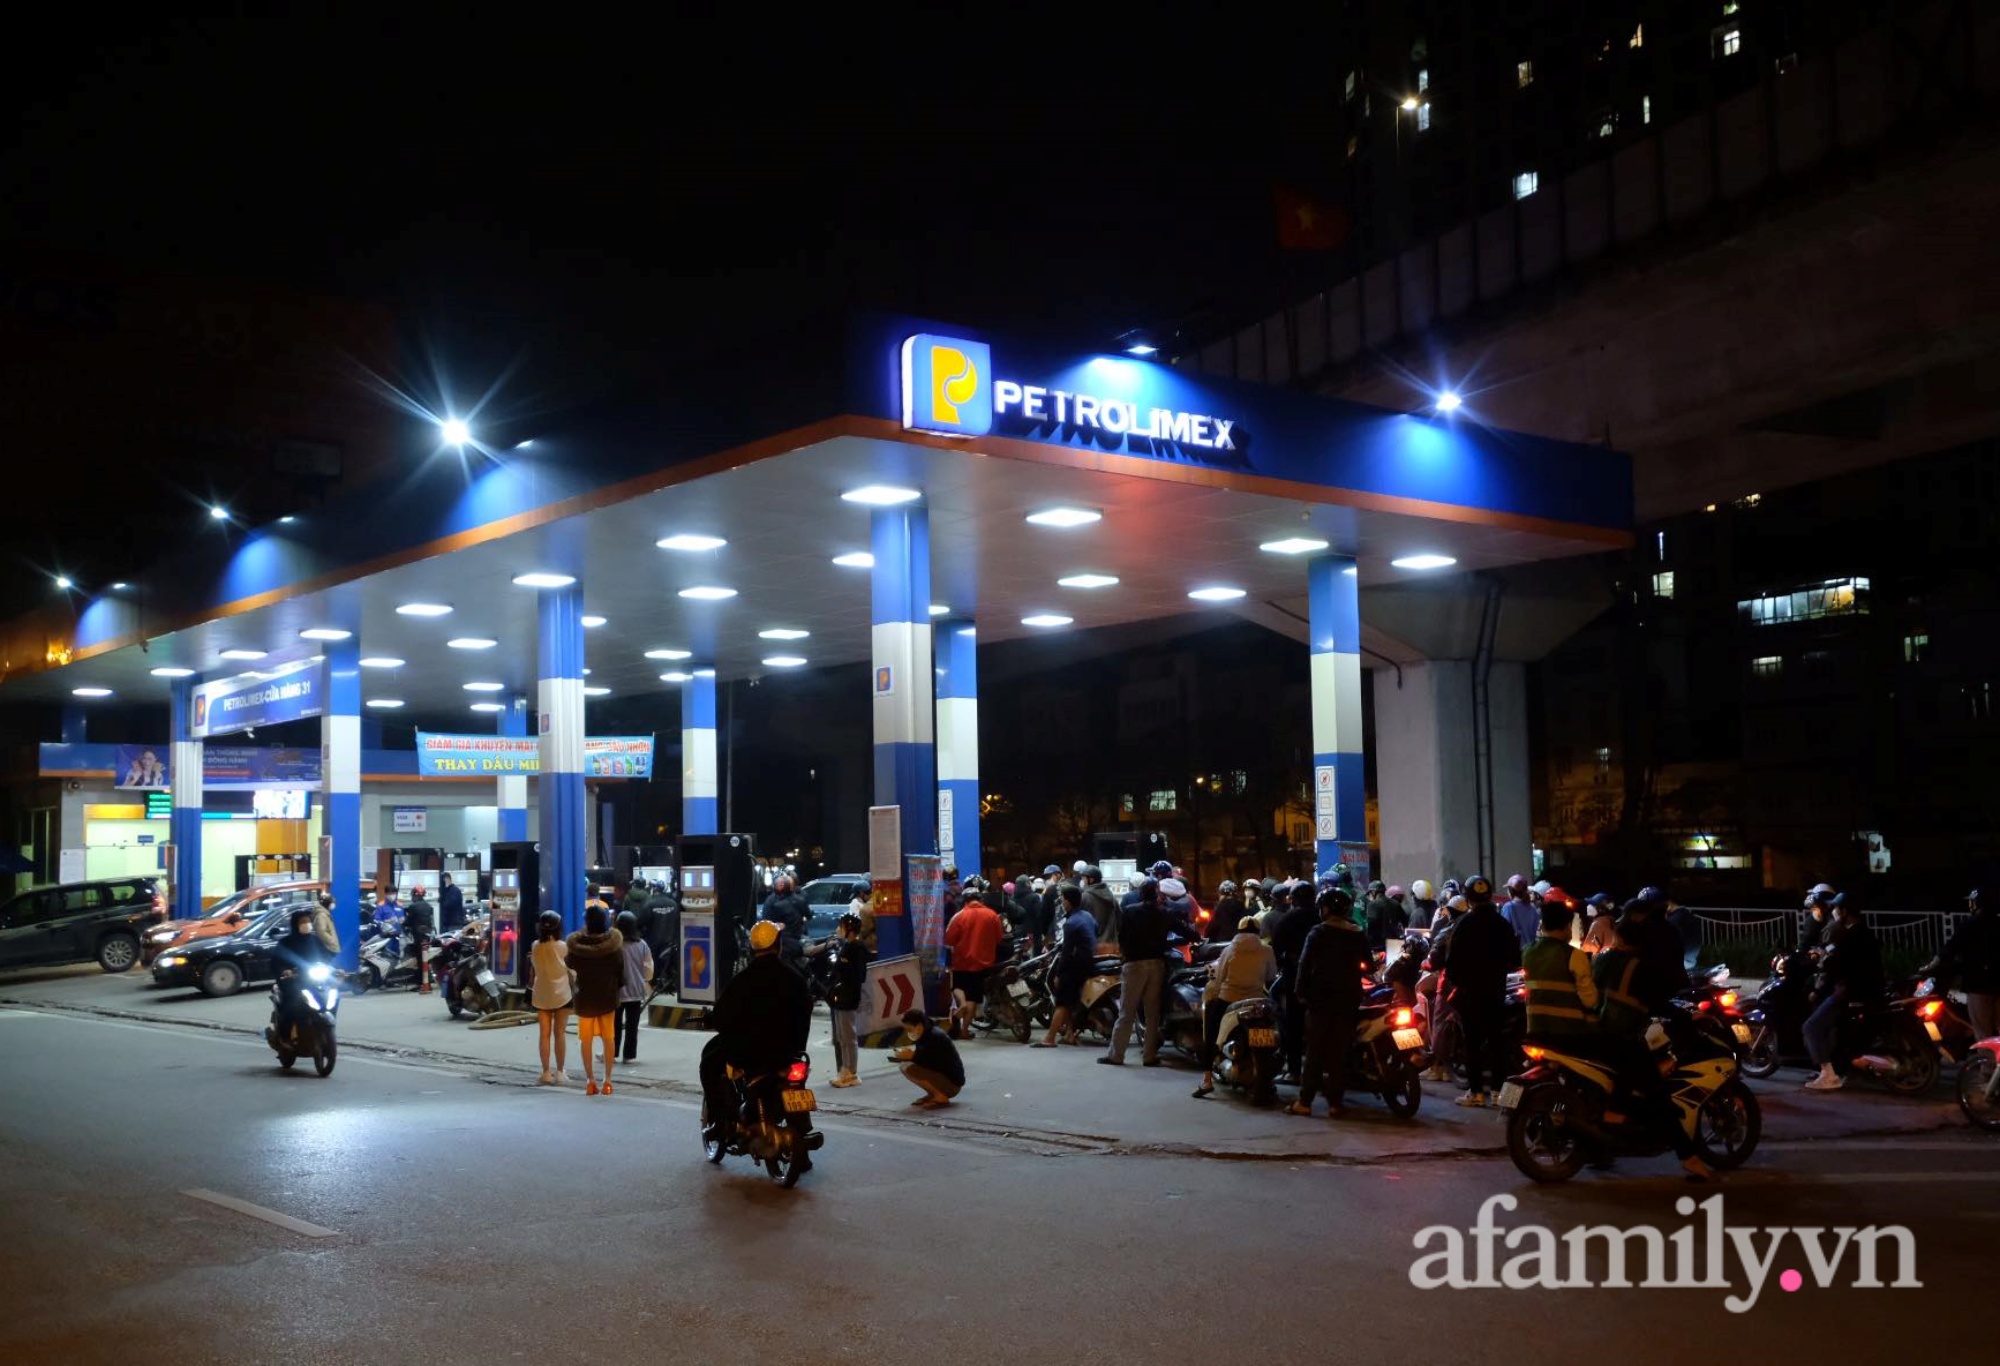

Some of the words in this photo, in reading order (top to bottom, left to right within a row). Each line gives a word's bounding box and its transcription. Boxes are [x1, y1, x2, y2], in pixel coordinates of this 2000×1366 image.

[994, 380, 1236, 450] PETROLIMEX
[302, 680, 311, 695] 31
[435, 759, 477, 771] THAY
[482, 755, 514, 771] DẦU
